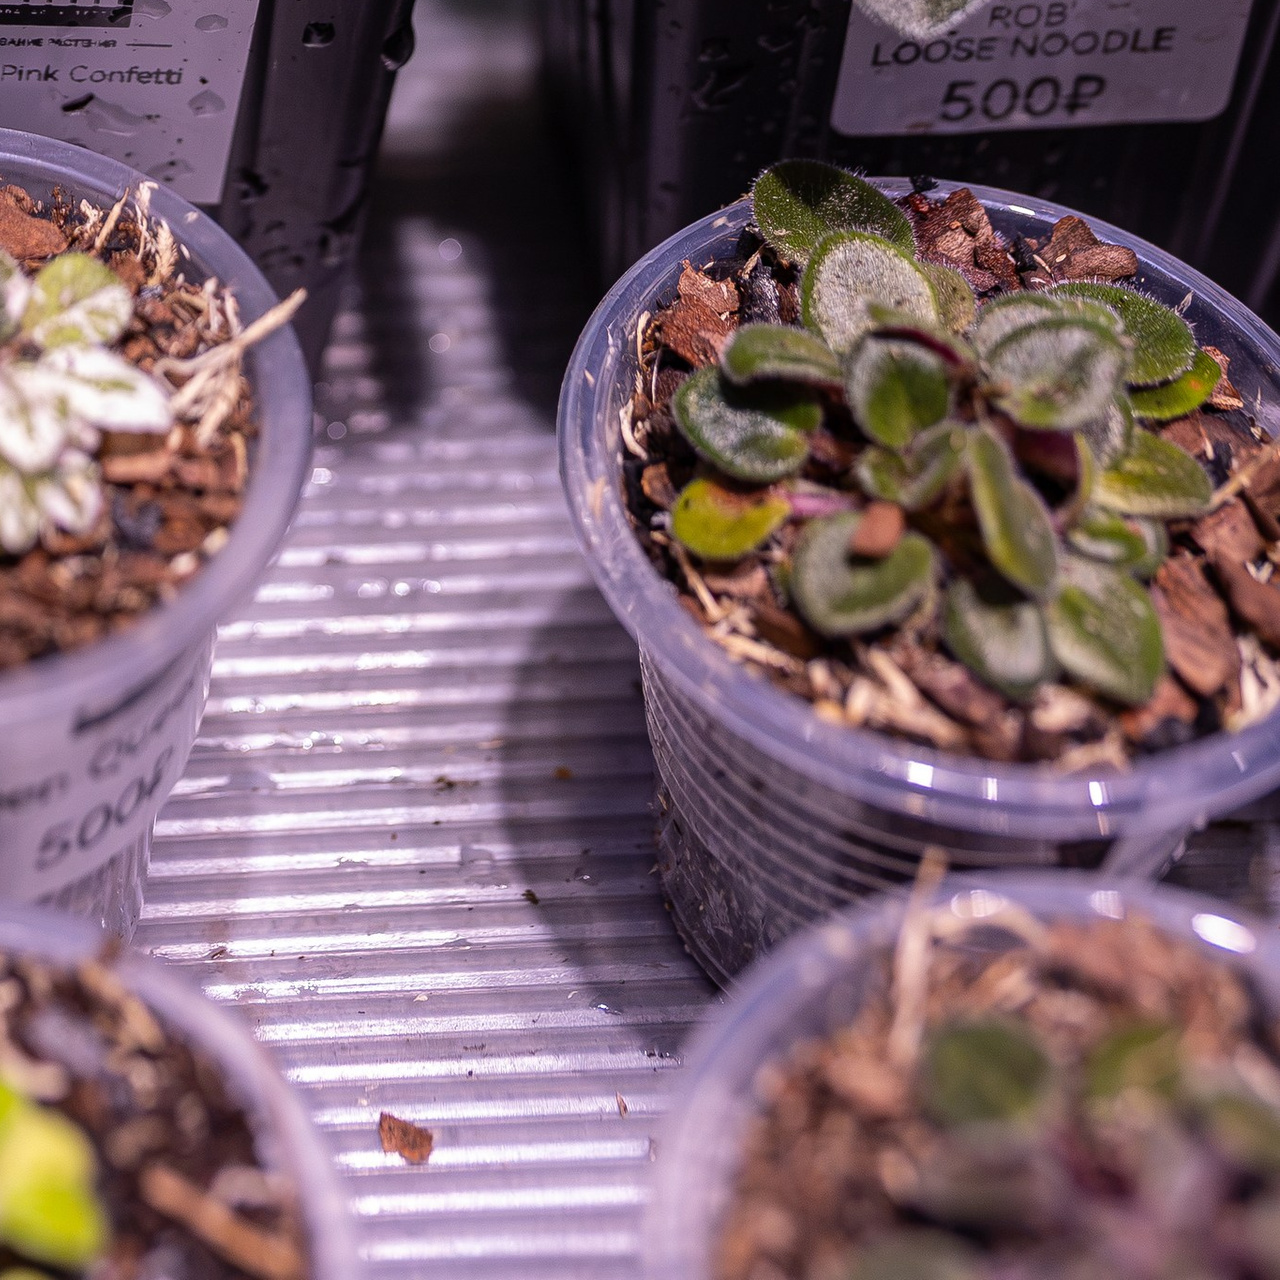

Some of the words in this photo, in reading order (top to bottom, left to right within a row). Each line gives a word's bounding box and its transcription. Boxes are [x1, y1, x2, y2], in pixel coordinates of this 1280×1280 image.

[870, 35, 998, 67] LOOSE
[1010, 26, 1177, 58] NOODLE
[0, 63, 59, 83] Pink
[70, 65, 183, 85] Confetti
[939, 73, 1107, 122] 500₽
